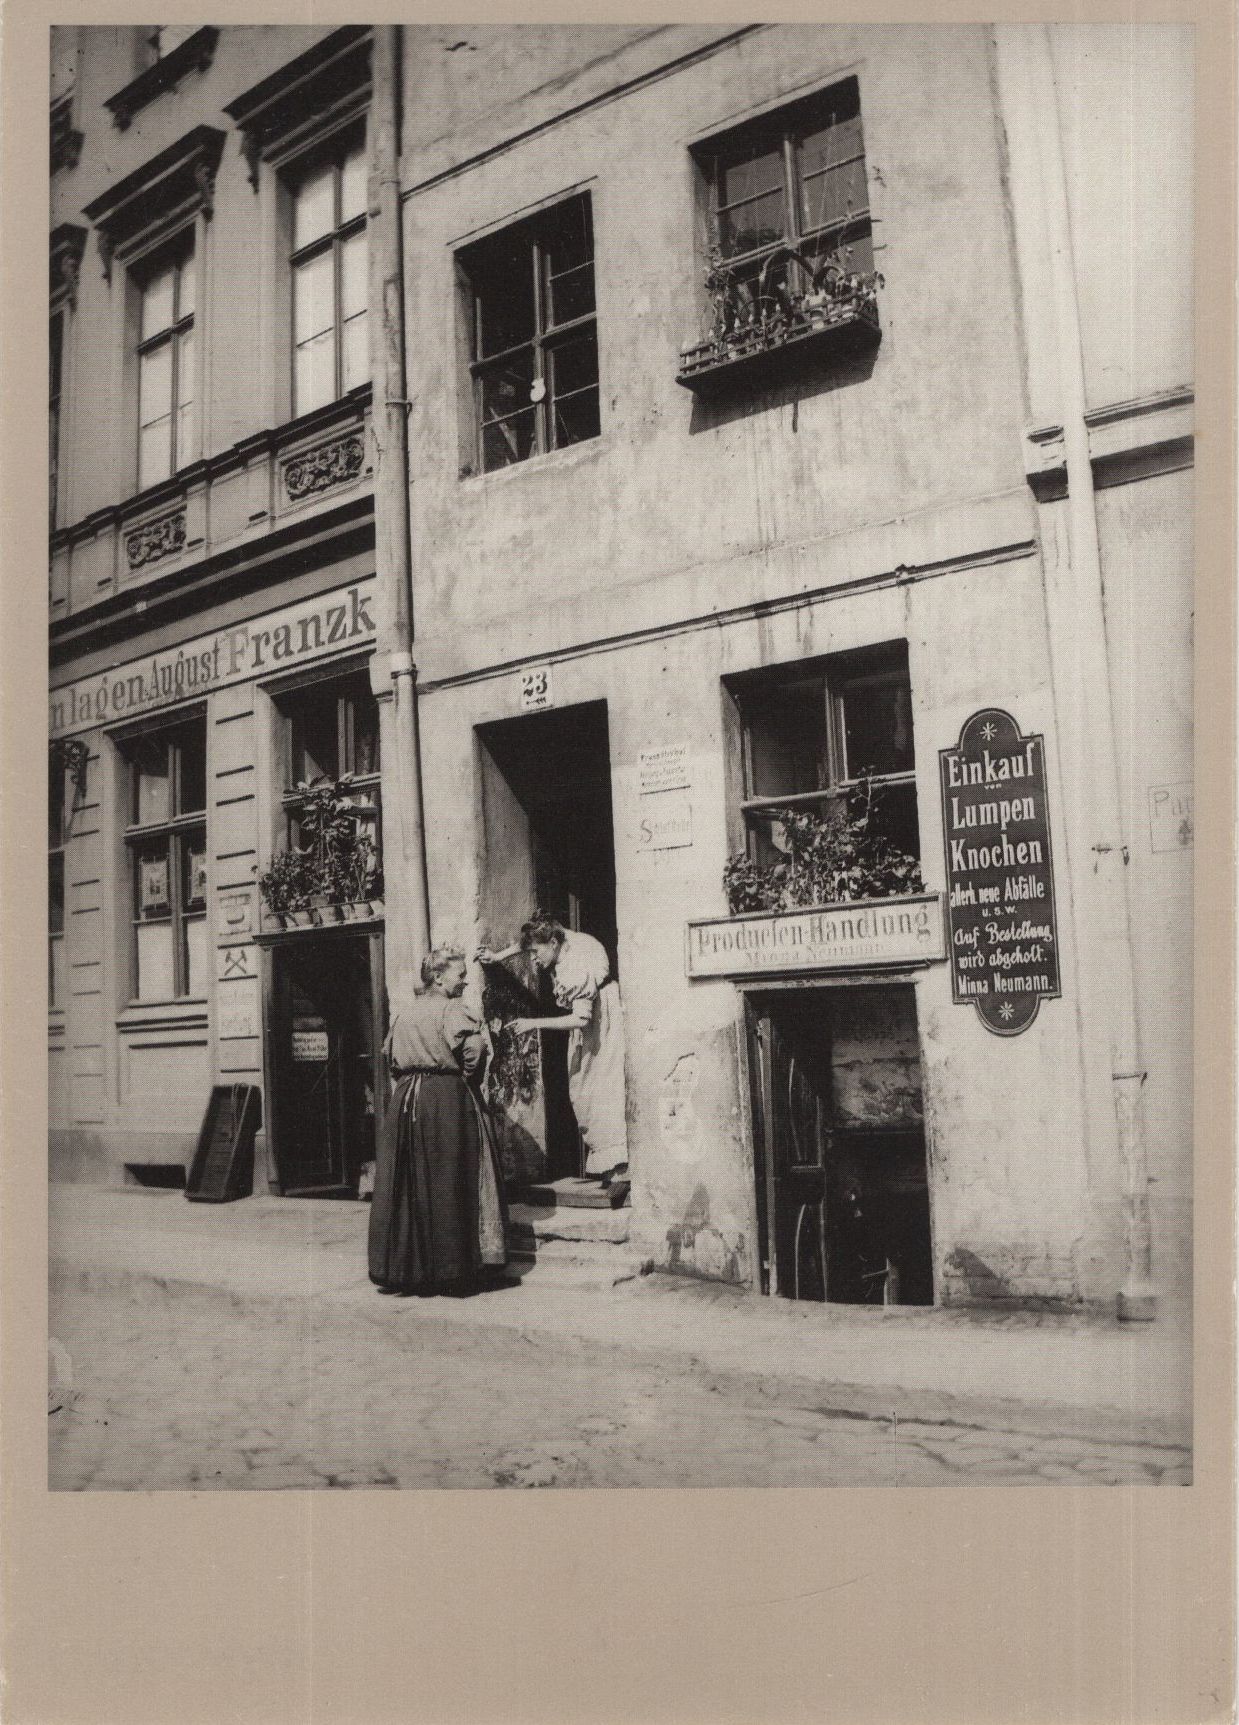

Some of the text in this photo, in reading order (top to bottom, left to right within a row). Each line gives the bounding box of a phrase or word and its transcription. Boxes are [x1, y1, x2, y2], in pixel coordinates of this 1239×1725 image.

[148, 637, 220, 699] August
[522, 671, 548, 698] 23
[947, 741, 1035, 788] Einkauf
[951, 796, 1036, 831] Lumpen
[950, 833, 1043, 873] Knochen
[978, 885, 1000, 904] neue
[1004, 874, 1045, 902] Abfälle
[984, 920, 1053, 945] Bestellung
[958, 944, 1048, 970] wird abgeholt.
[957, 971, 1054, 995] Minna Neumann.
